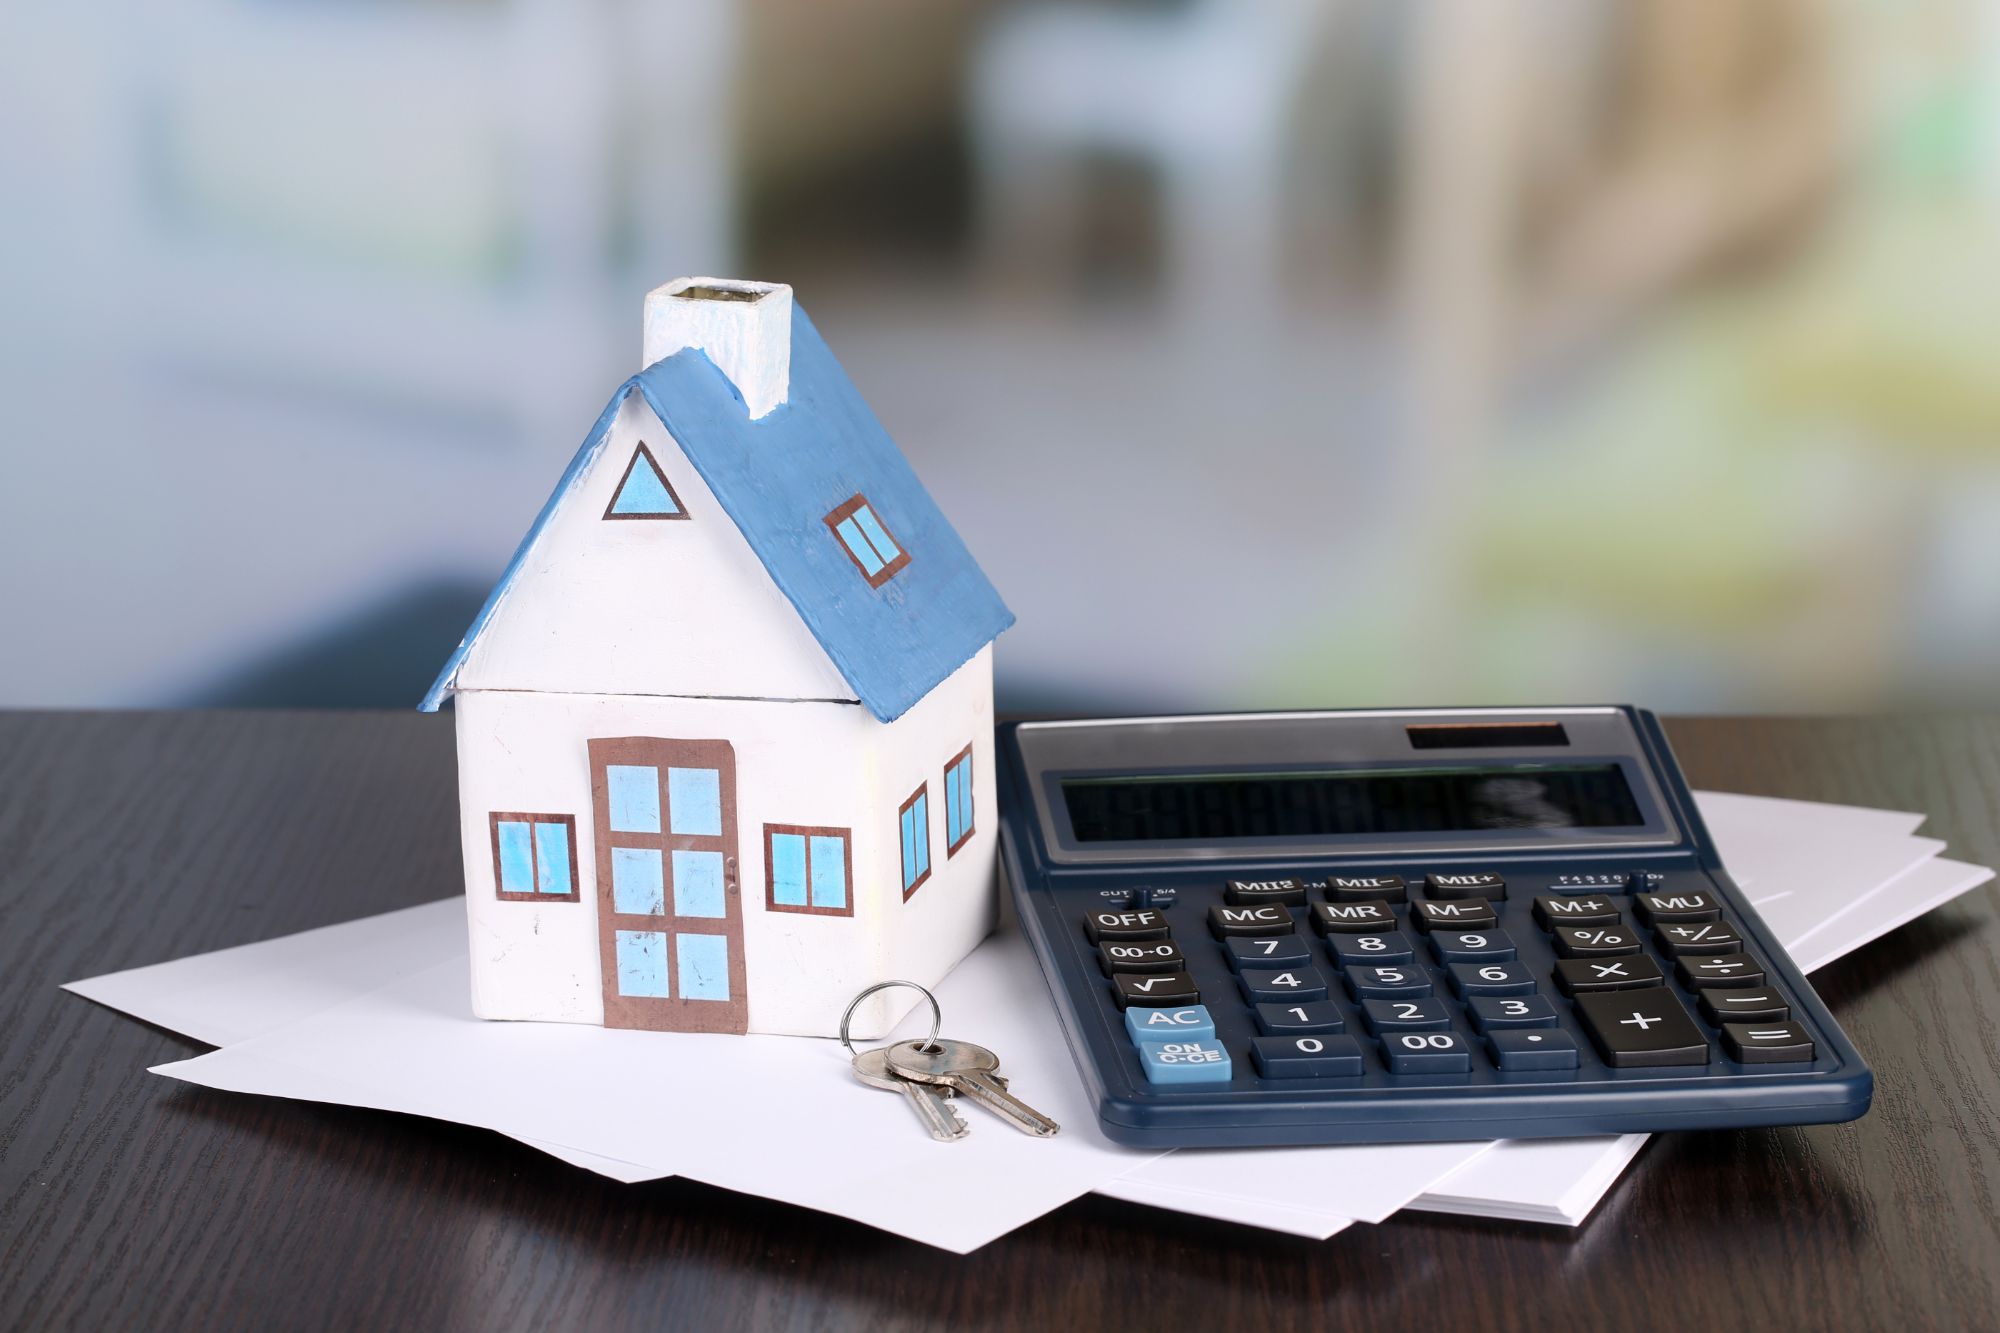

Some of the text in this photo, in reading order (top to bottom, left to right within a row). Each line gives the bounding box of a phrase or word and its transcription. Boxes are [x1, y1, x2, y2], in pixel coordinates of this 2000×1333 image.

[1435, 875, 1494, 885] MII+
[1548, 900, 1604, 913] M+
[1650, 895, 1704, 909] MU
[1221, 907, 1279, 921] MC
[1326, 905, 1382, 918] MR
[1426, 903, 1483, 916] M-
[1098, 912, 1156, 926] OFF
[1254, 940, 1279, 954] 7
[1357, 937, 1387, 951] 8
[1459, 934, 1488, 948] 9
[1271, 973, 1302, 987] 4
[1374, 967, 1404, 982] 5
[1478, 966, 1508, 981] 6
[1288, 1007, 1309, 1022] 1
[1392, 1003, 1425, 1019] 2
[1499, 1000, 1530, 1015] 3
[1148, 1010, 1200, 1025] AC
[1163, 1043, 1202, 1053] ON
[1295, 1038, 1324, 1053] 0
[1401, 1034, 1454, 1049] 00
